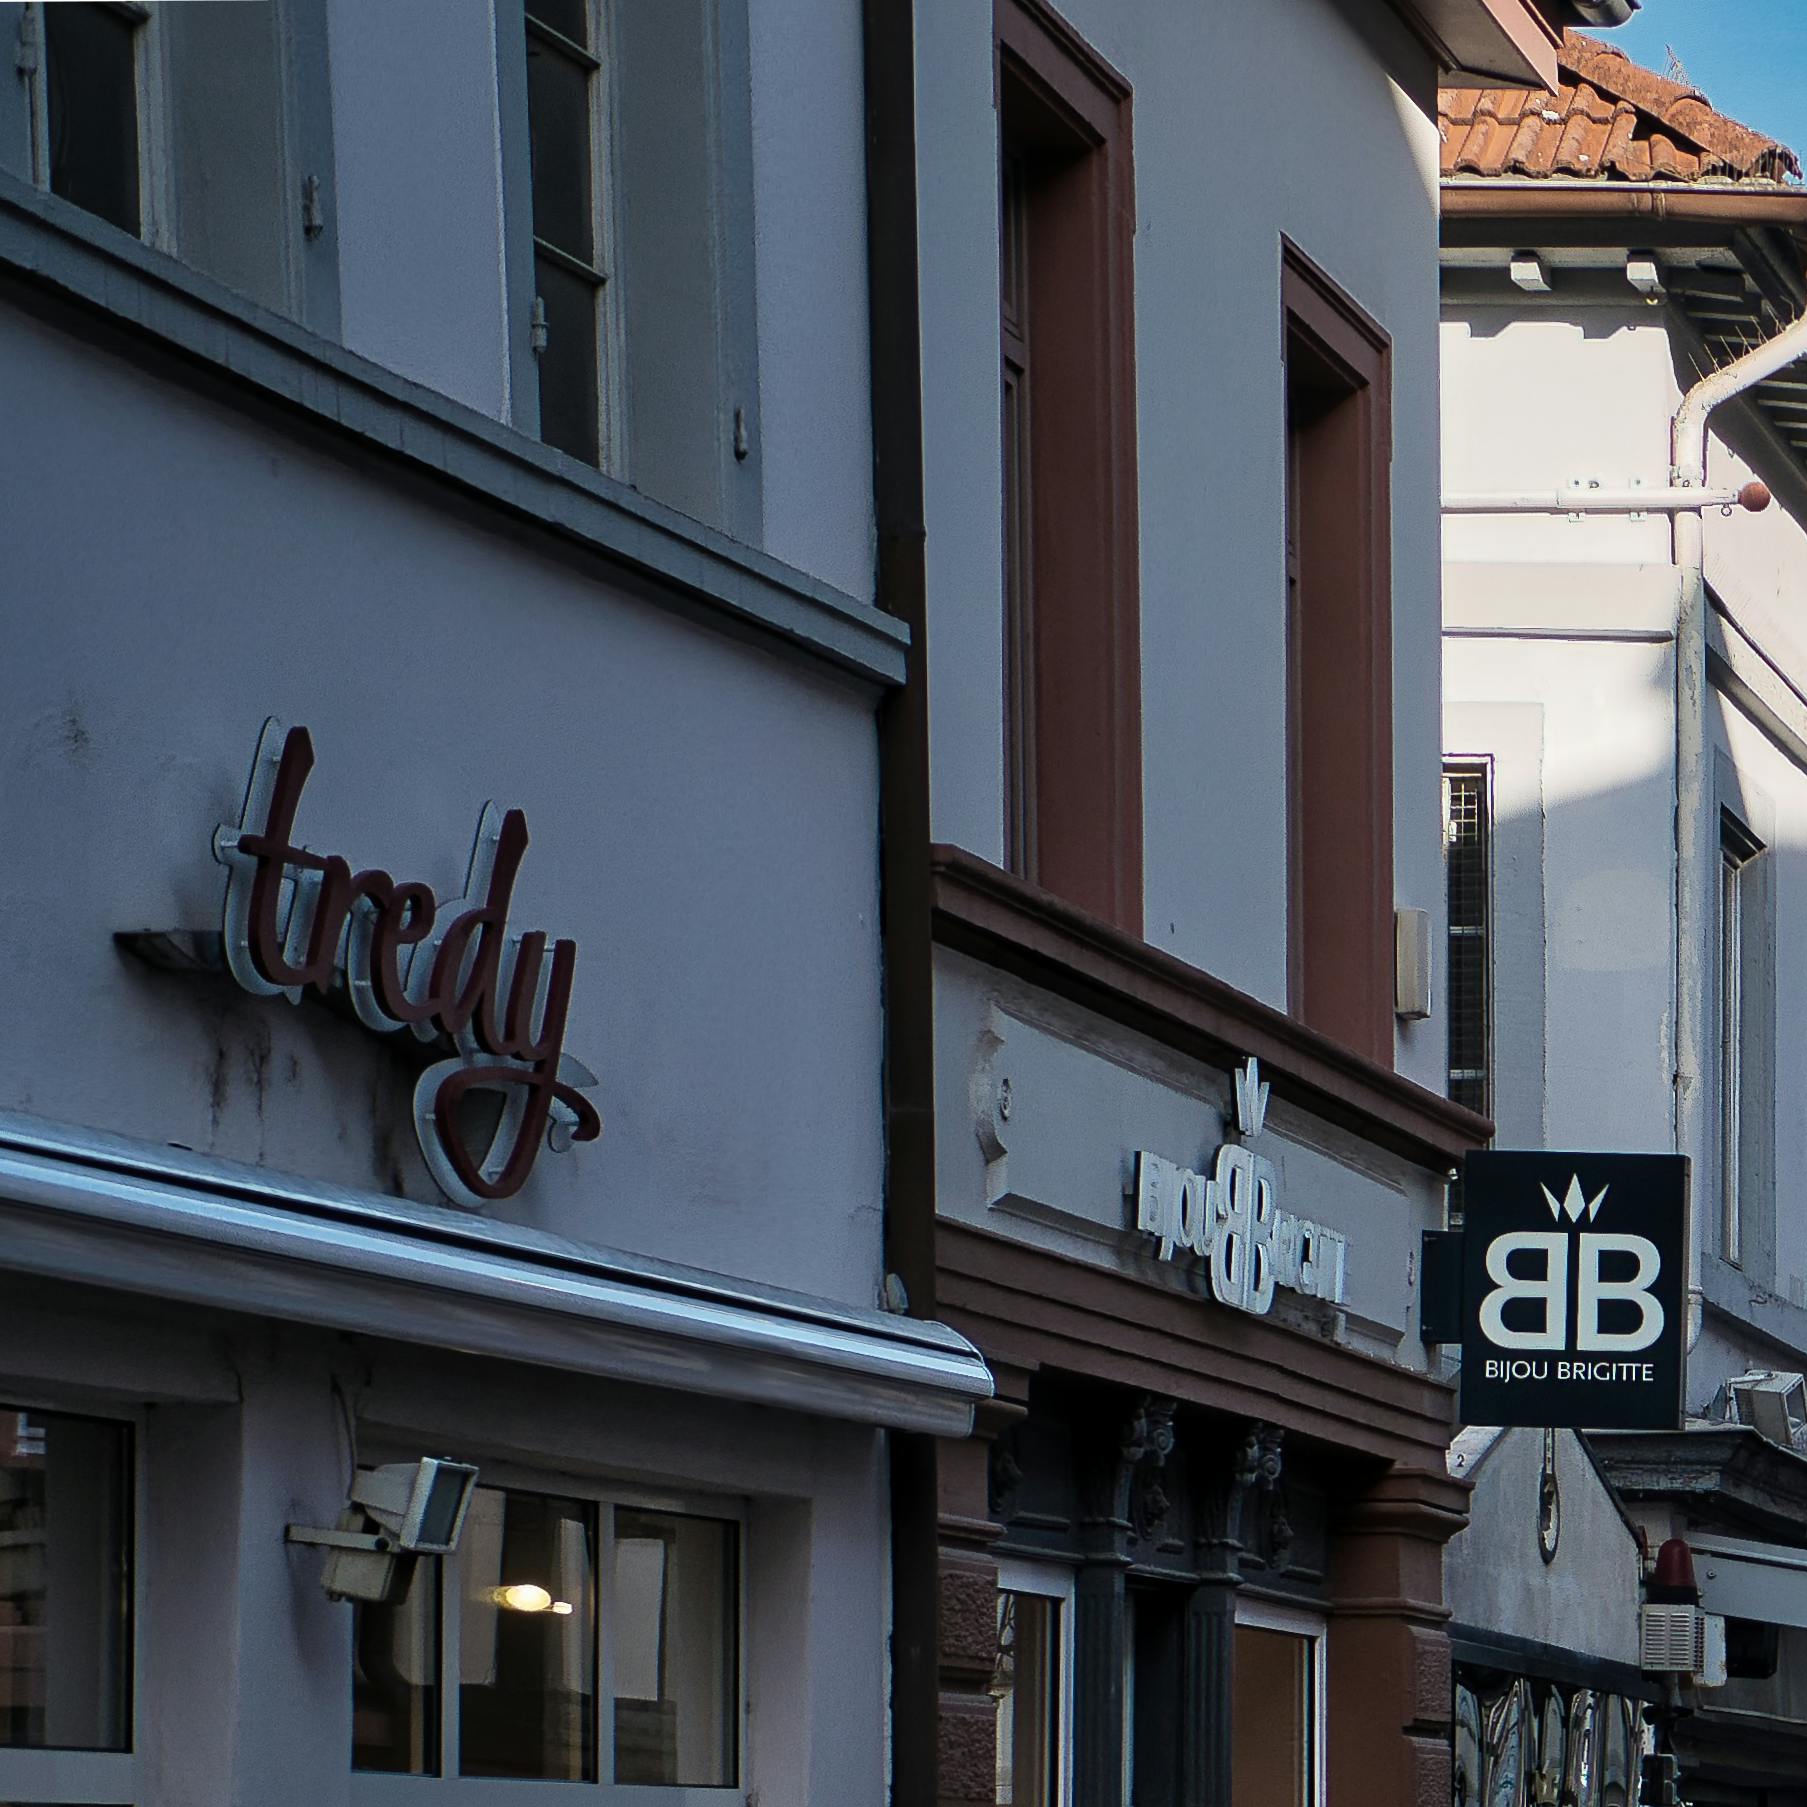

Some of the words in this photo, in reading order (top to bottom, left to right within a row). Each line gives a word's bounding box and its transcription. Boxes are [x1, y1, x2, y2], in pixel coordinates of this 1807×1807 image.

[213, 717, 601, 1205] tredy
[1484, 1360, 1548, 1383] BIJOU
[1557, 1362, 1655, 1382] BRIGITTE
[1456, 1453, 1465, 1468] 2
